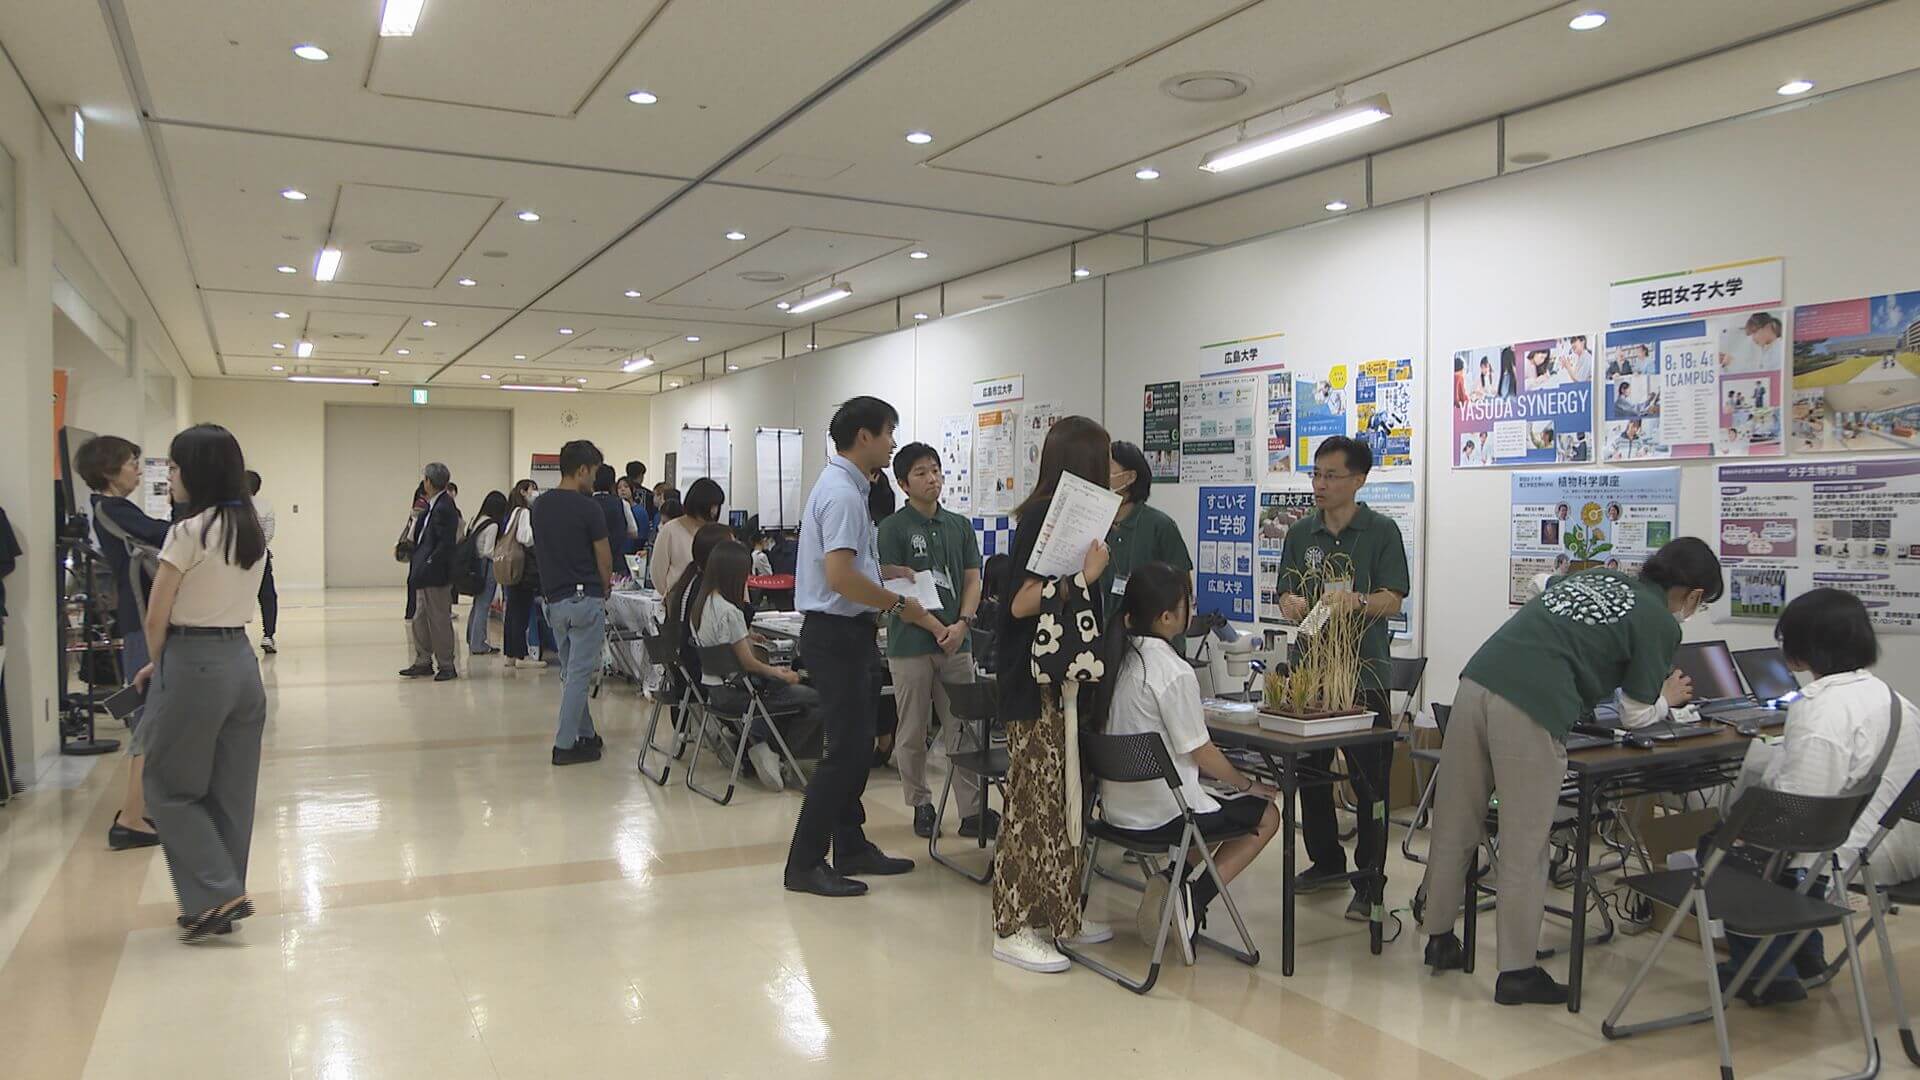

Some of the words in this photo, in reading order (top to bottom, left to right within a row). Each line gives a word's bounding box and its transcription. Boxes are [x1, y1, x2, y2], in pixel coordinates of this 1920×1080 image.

[1641, 277, 1744, 309] 安田女子大学
[1224, 347, 1259, 365] 広島大学
[982, 383, 1013, 398] 広島市立大学
[1458, 399, 1513, 422] YASUDA
[1517, 390, 1589, 418] SYNERGY
[1787, 464, 1858, 478] 分子生物学講座
[1558, 476, 1621, 488] 植物科学講座
[1206, 494, 1246, 510] すごいぞ
[1206, 515, 1246, 536] 工学部
[1207, 580, 1243, 595] 広島大学
